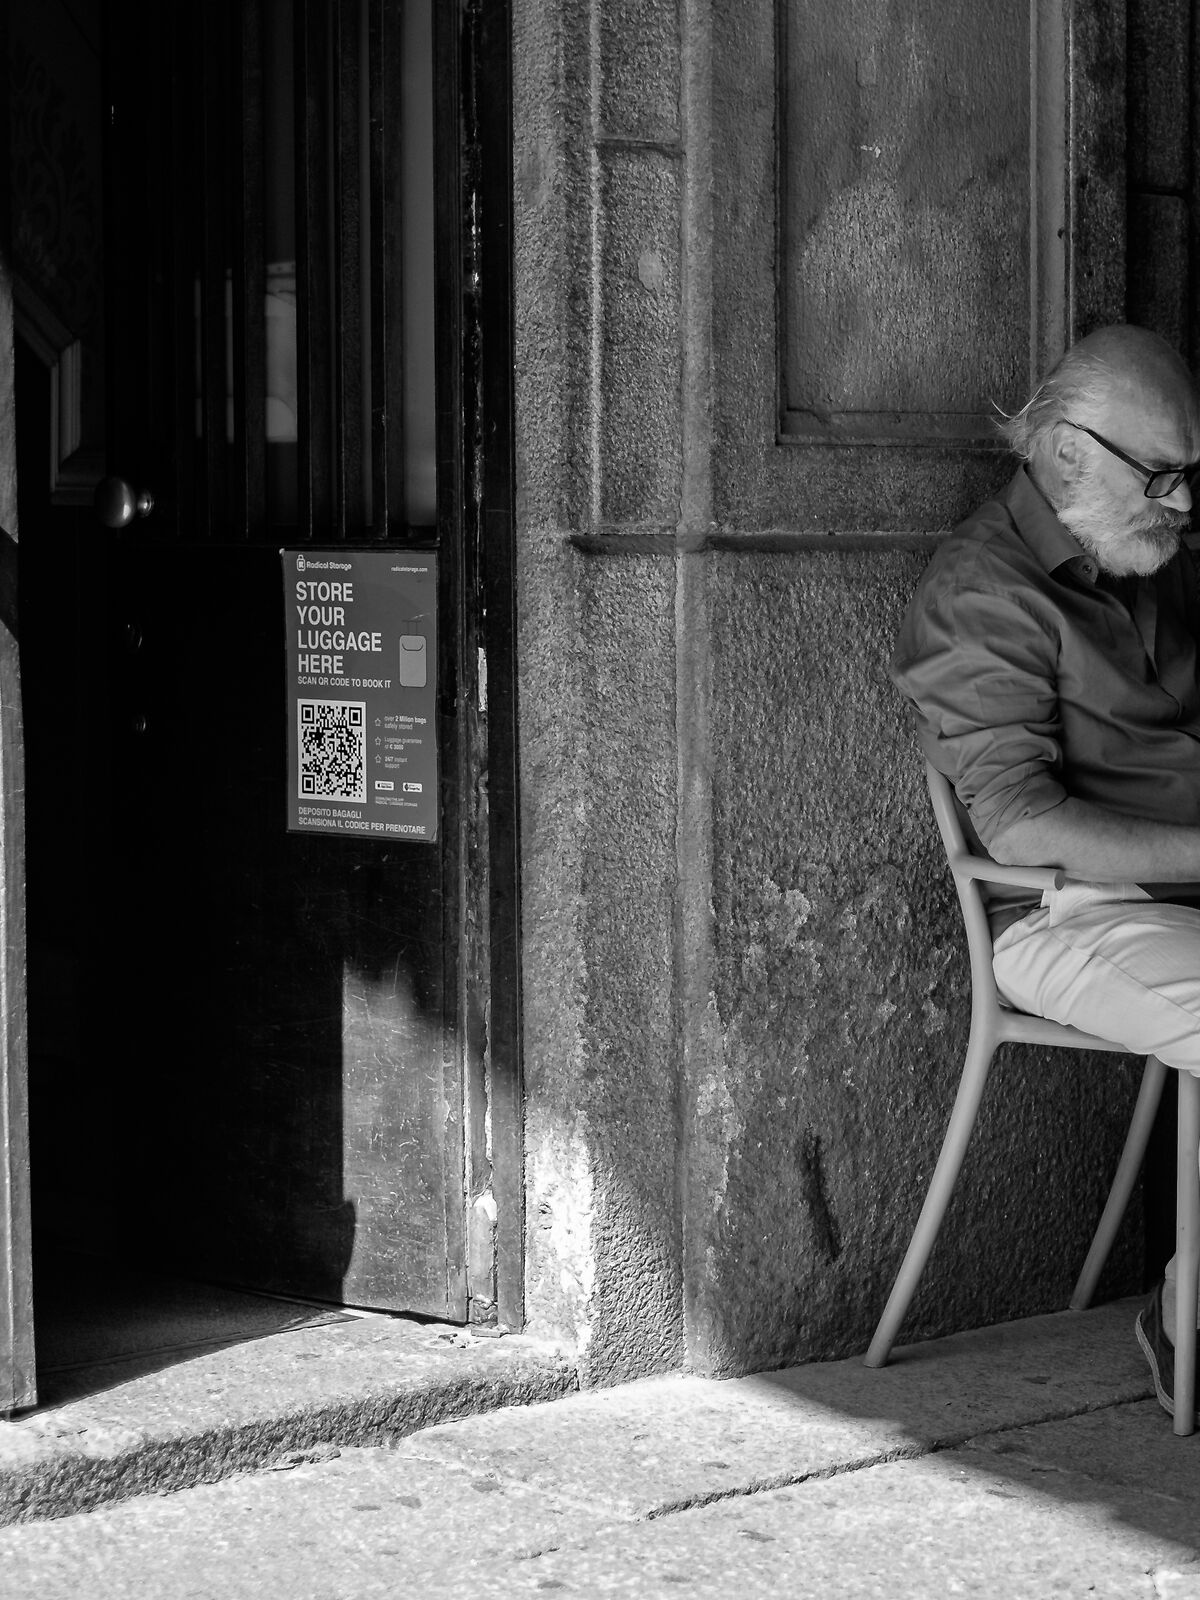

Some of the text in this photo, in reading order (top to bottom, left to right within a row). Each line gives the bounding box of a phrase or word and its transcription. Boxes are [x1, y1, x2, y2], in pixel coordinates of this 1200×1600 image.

[307, 561, 352, 571] Radical Storage
[296, 581, 354, 602] STORE
[296, 605, 345, 626] YOUR
[298, 630, 382, 652] LUGGAGE
[298, 654, 344, 674] HERE
[298, 676, 391, 688] SCAN QR CODE TO BOOK IT
[298, 807, 362, 818] DEPOSITO BAGAGLI
[298, 818, 426, 834] SCANSIONA IL CODICE PER PRENOTARE
